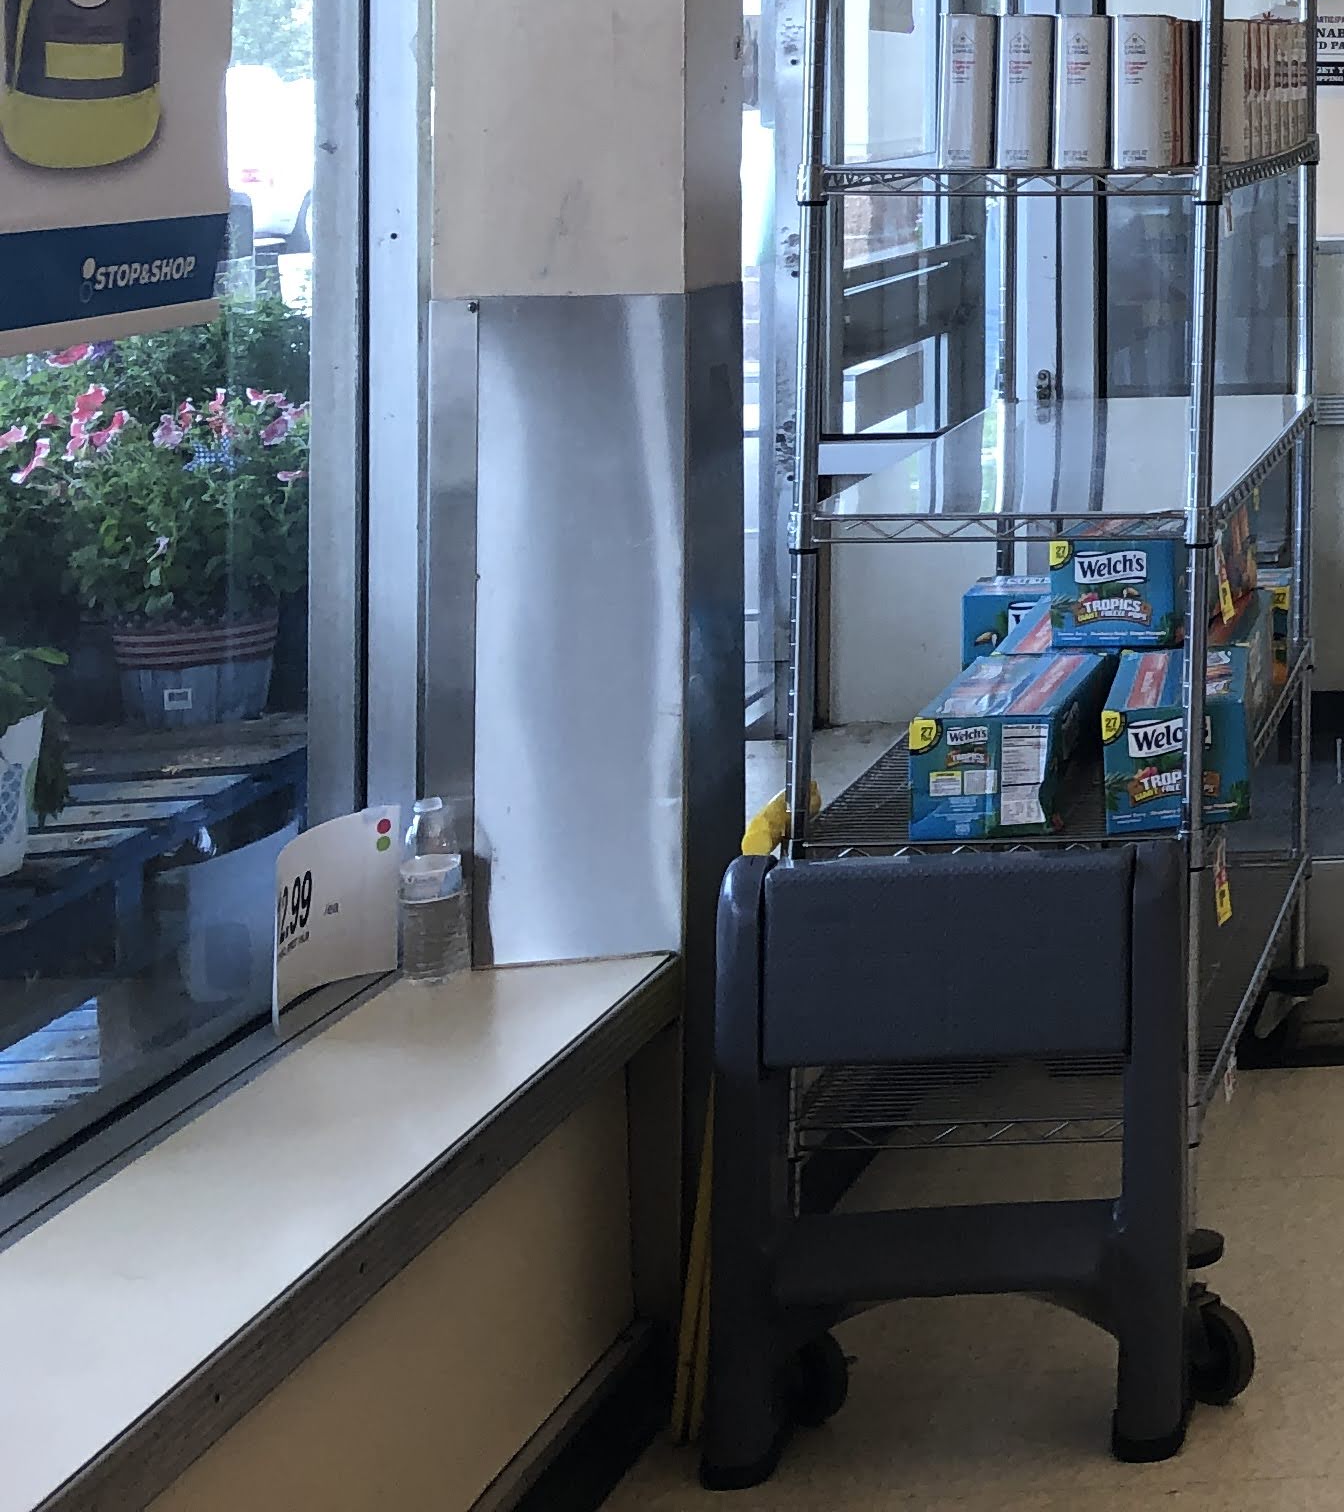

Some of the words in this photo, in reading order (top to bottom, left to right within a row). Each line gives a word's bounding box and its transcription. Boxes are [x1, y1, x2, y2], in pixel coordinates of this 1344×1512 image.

[94, 255, 196, 291] STOP&SHOP
[1055, 545, 1067, 554] 27
[1077, 554, 1145, 579] Welch's
[1083, 598, 1142, 612] TROPICS
[1104, 717, 1118, 728] 27
[920, 726, 933, 737] 27
[949, 728, 987, 742] Welch's
[1131, 723, 1184, 752] Welc
[1139, 770, 1183, 790] TROP
